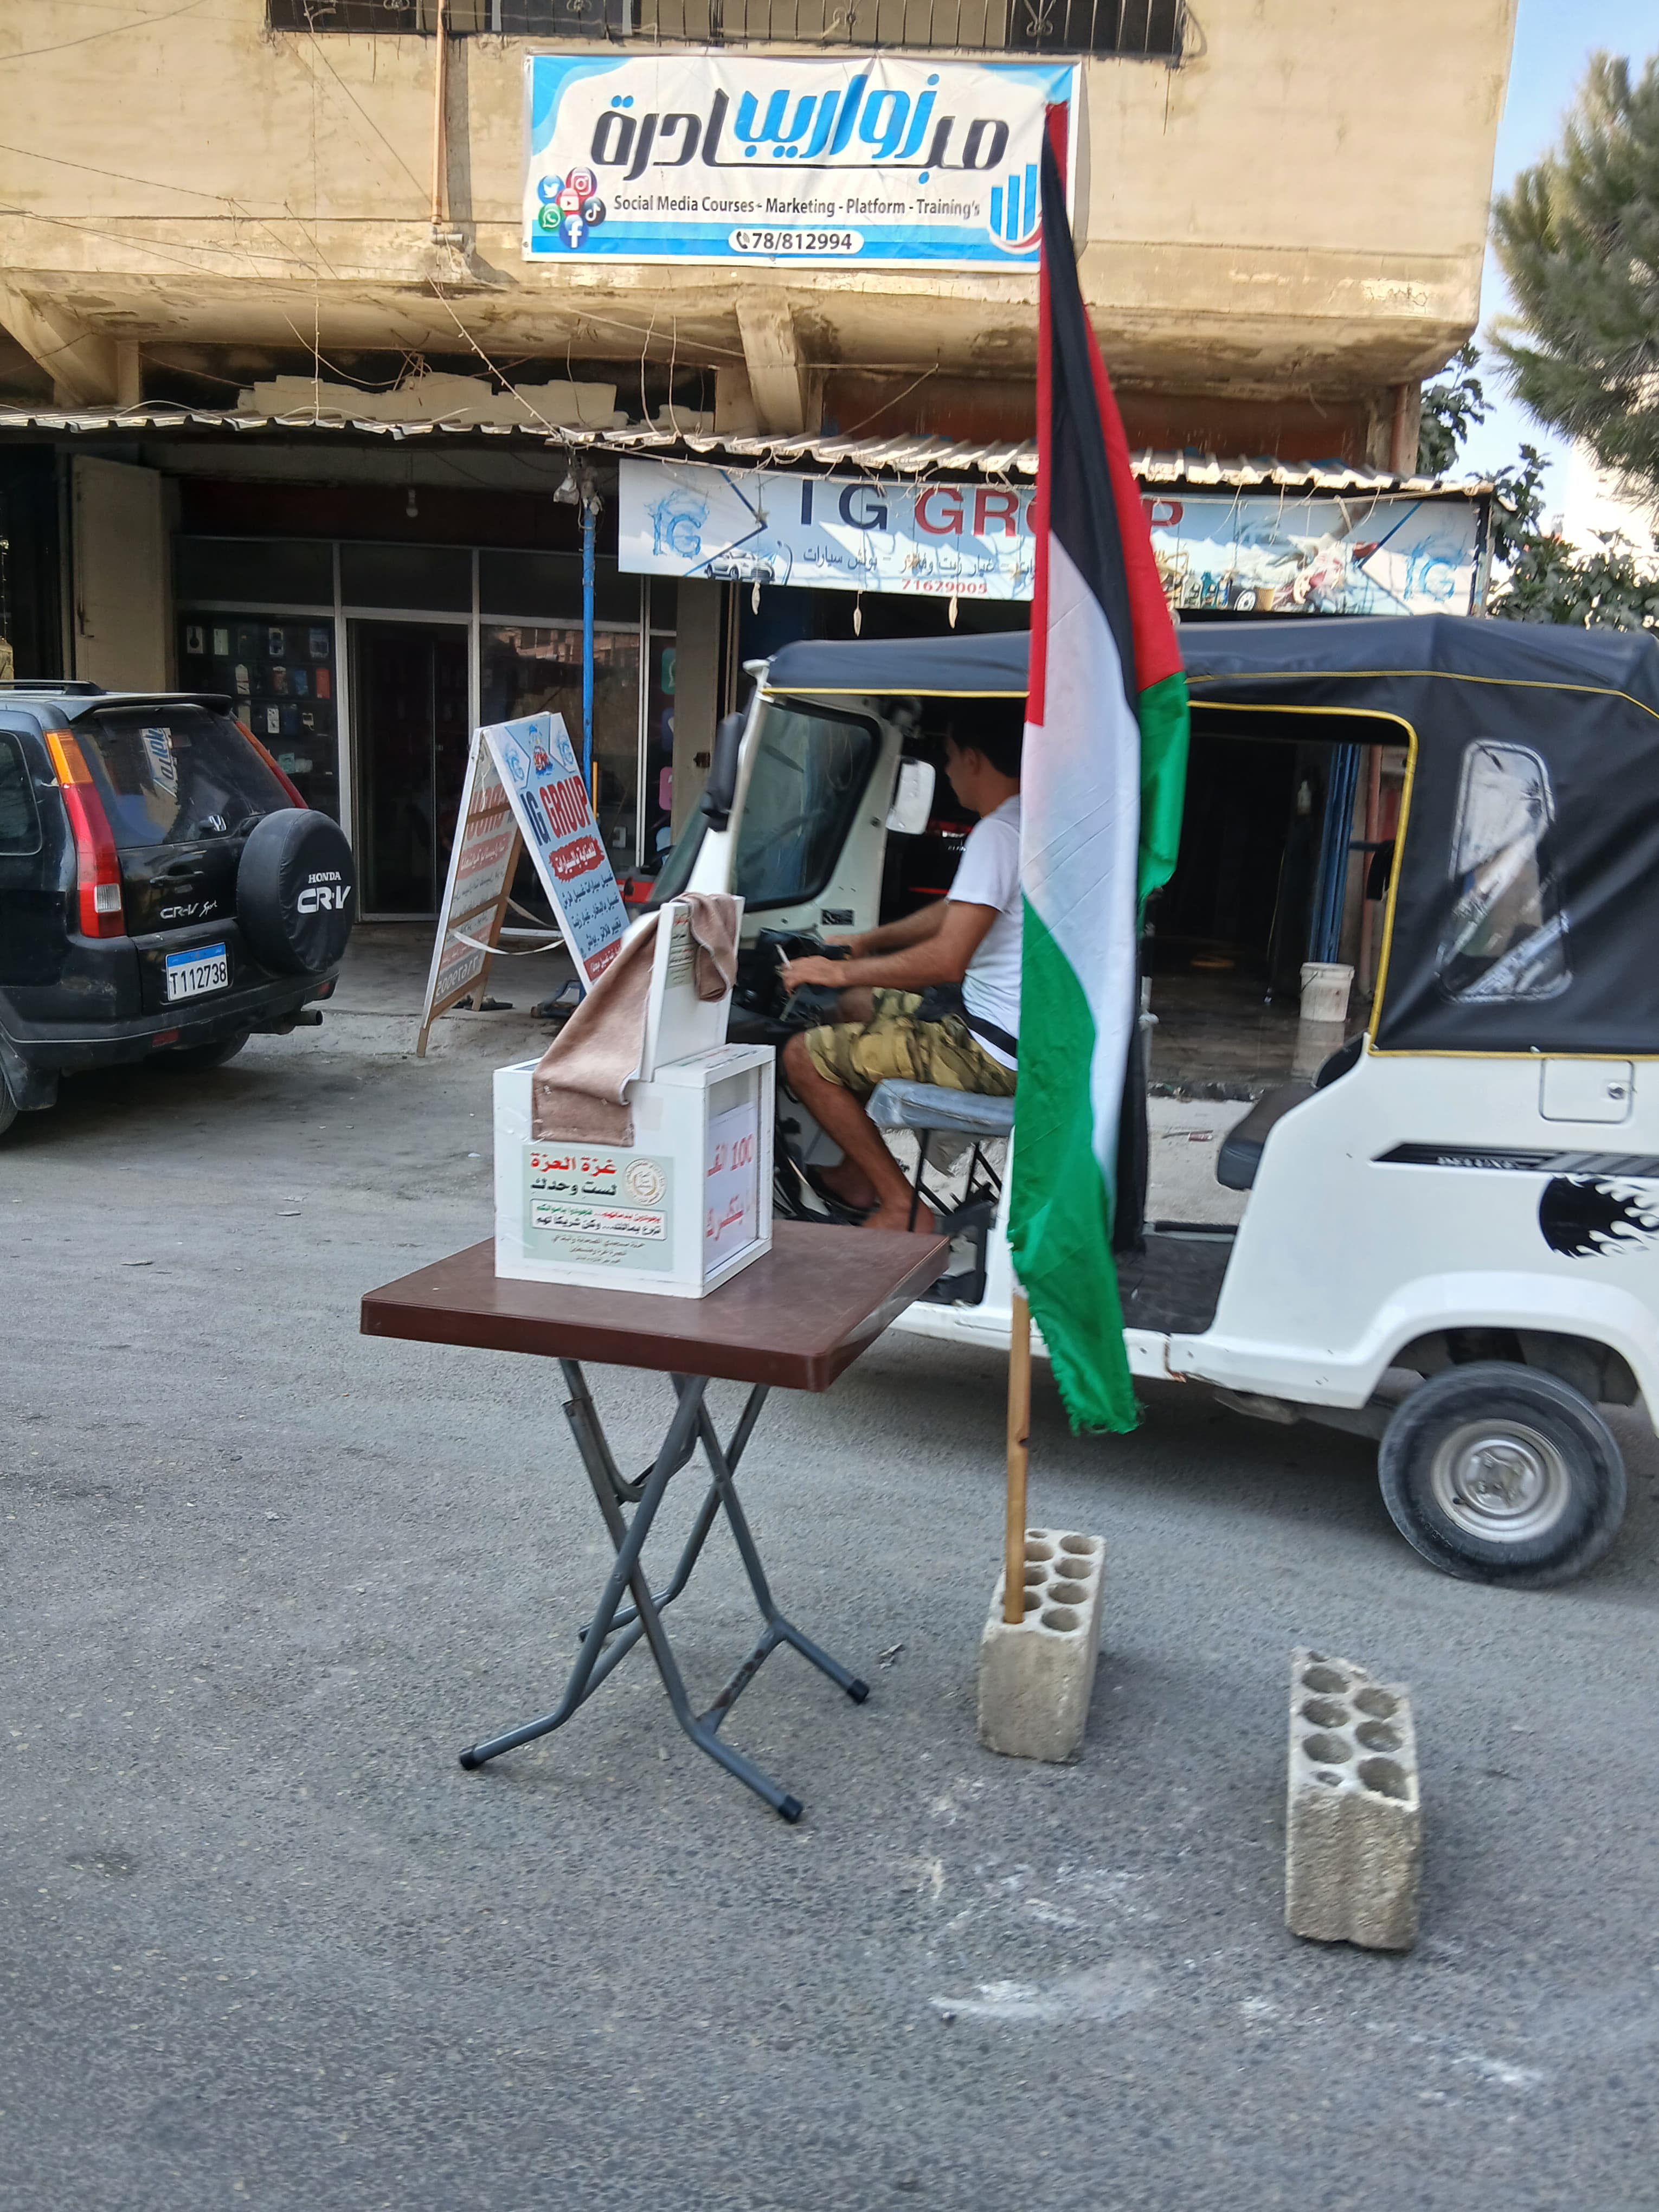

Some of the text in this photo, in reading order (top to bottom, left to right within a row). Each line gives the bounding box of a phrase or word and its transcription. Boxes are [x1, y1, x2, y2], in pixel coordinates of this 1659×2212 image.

[734, 73, 940, 159] زواريب
[613, 195, 653, 211] Social
[657, 196, 698, 211] Media
[766, 198, 835, 217] Marketing
[846, 198, 905, 214] Platform
[917, 199, 980, 220] Training's
[752, 233, 852, 251] 78/812994
[803, 544, 843, 569] سيارات
[519, 775, 591, 847] IG GROUP
[308, 871, 342, 884] HONDA
[160, 899, 218, 919] CR-V Sport
[297, 885, 351, 914] CR-V
[169, 961, 227, 995] T112738
[530, 1152, 617, 1177] غزة العزة
